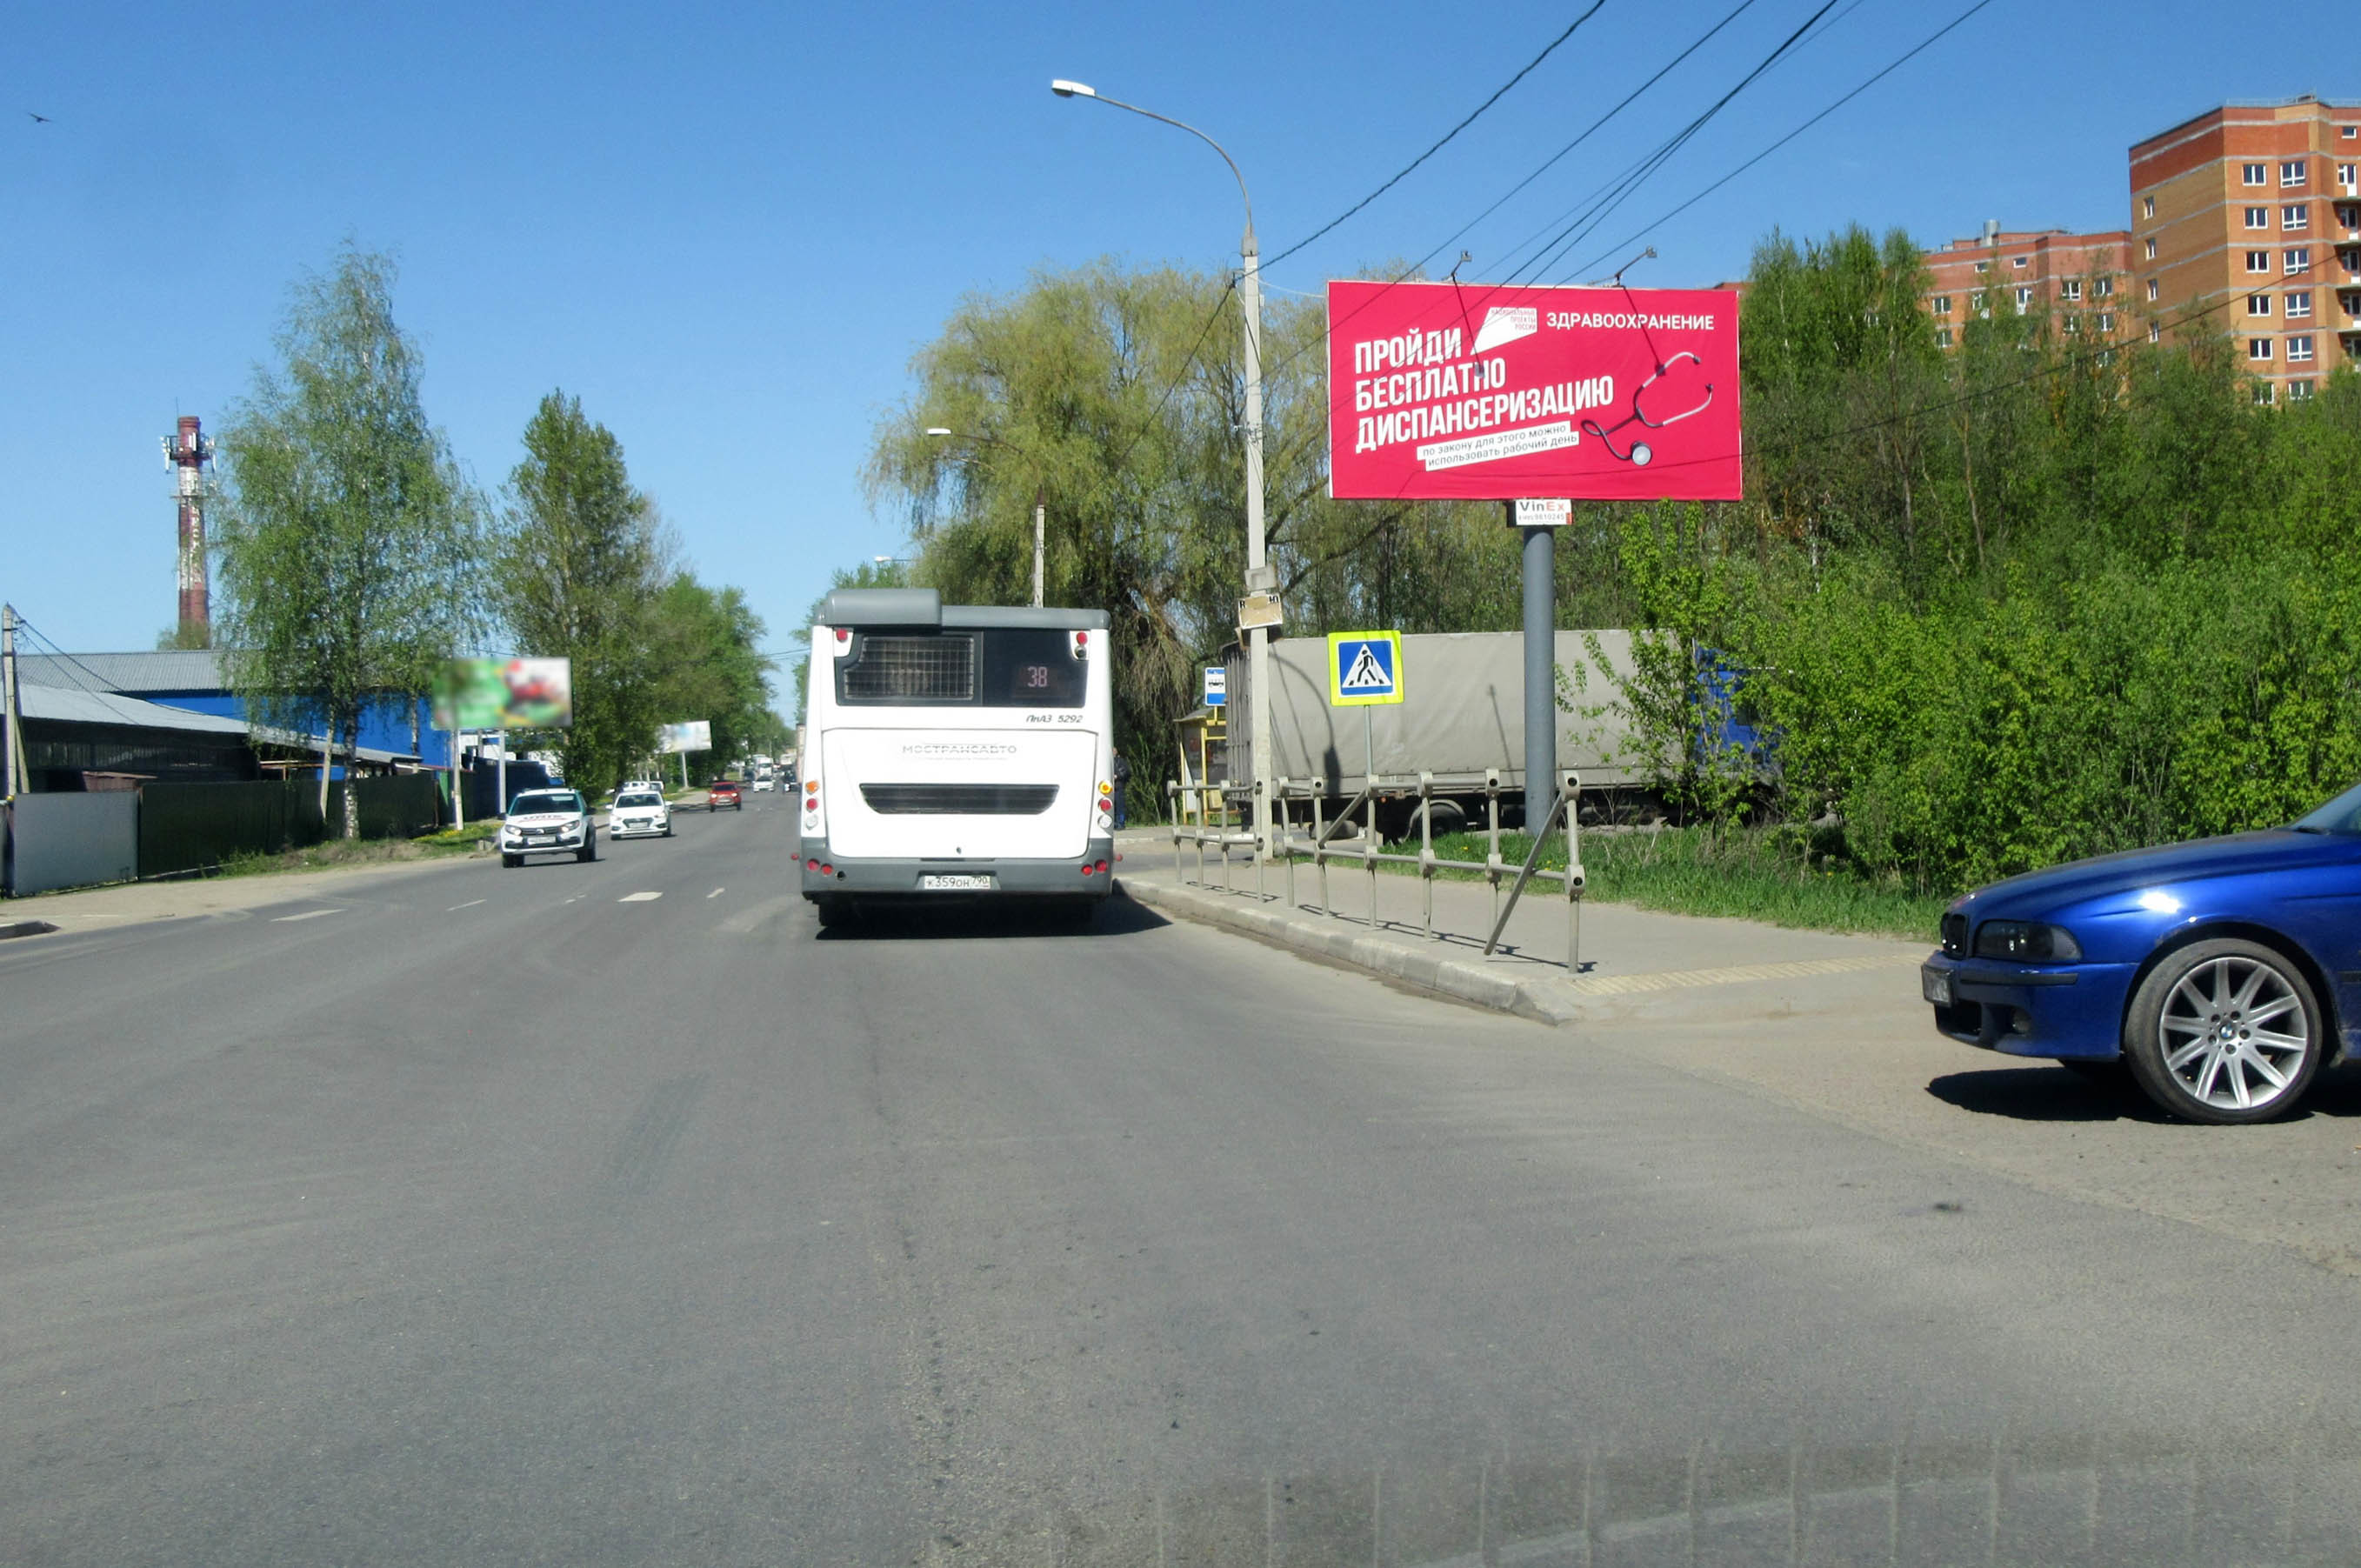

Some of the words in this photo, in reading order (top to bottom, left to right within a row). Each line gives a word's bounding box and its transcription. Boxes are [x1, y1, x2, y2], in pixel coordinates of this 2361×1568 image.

[1546, 312, 1715, 330] ЗДРАВООХРАНЕНИЕ
[1355, 327, 1462, 375] ПРОЙДИ
[1356, 357, 1506, 412] БЕСПЛАТНО
[1355, 375, 1614, 454] ДИСПАНСЕРИЗАЦИЮ
[1423, 448, 1435, 457] по
[1438, 441, 1472, 455] закону
[1475, 437, 1495, 449] для
[1497, 431, 1526, 444] этого
[1529, 424, 1566, 438] можно
[1428, 448, 1500, 467] использовать
[1504, 437, 1548, 455] рабочий
[1551, 434, 1577, 448] день
[1519, 501, 1565, 511] VinEx
[1027, 666, 1048, 687] 38
[1057, 714, 1084, 723] 5292
